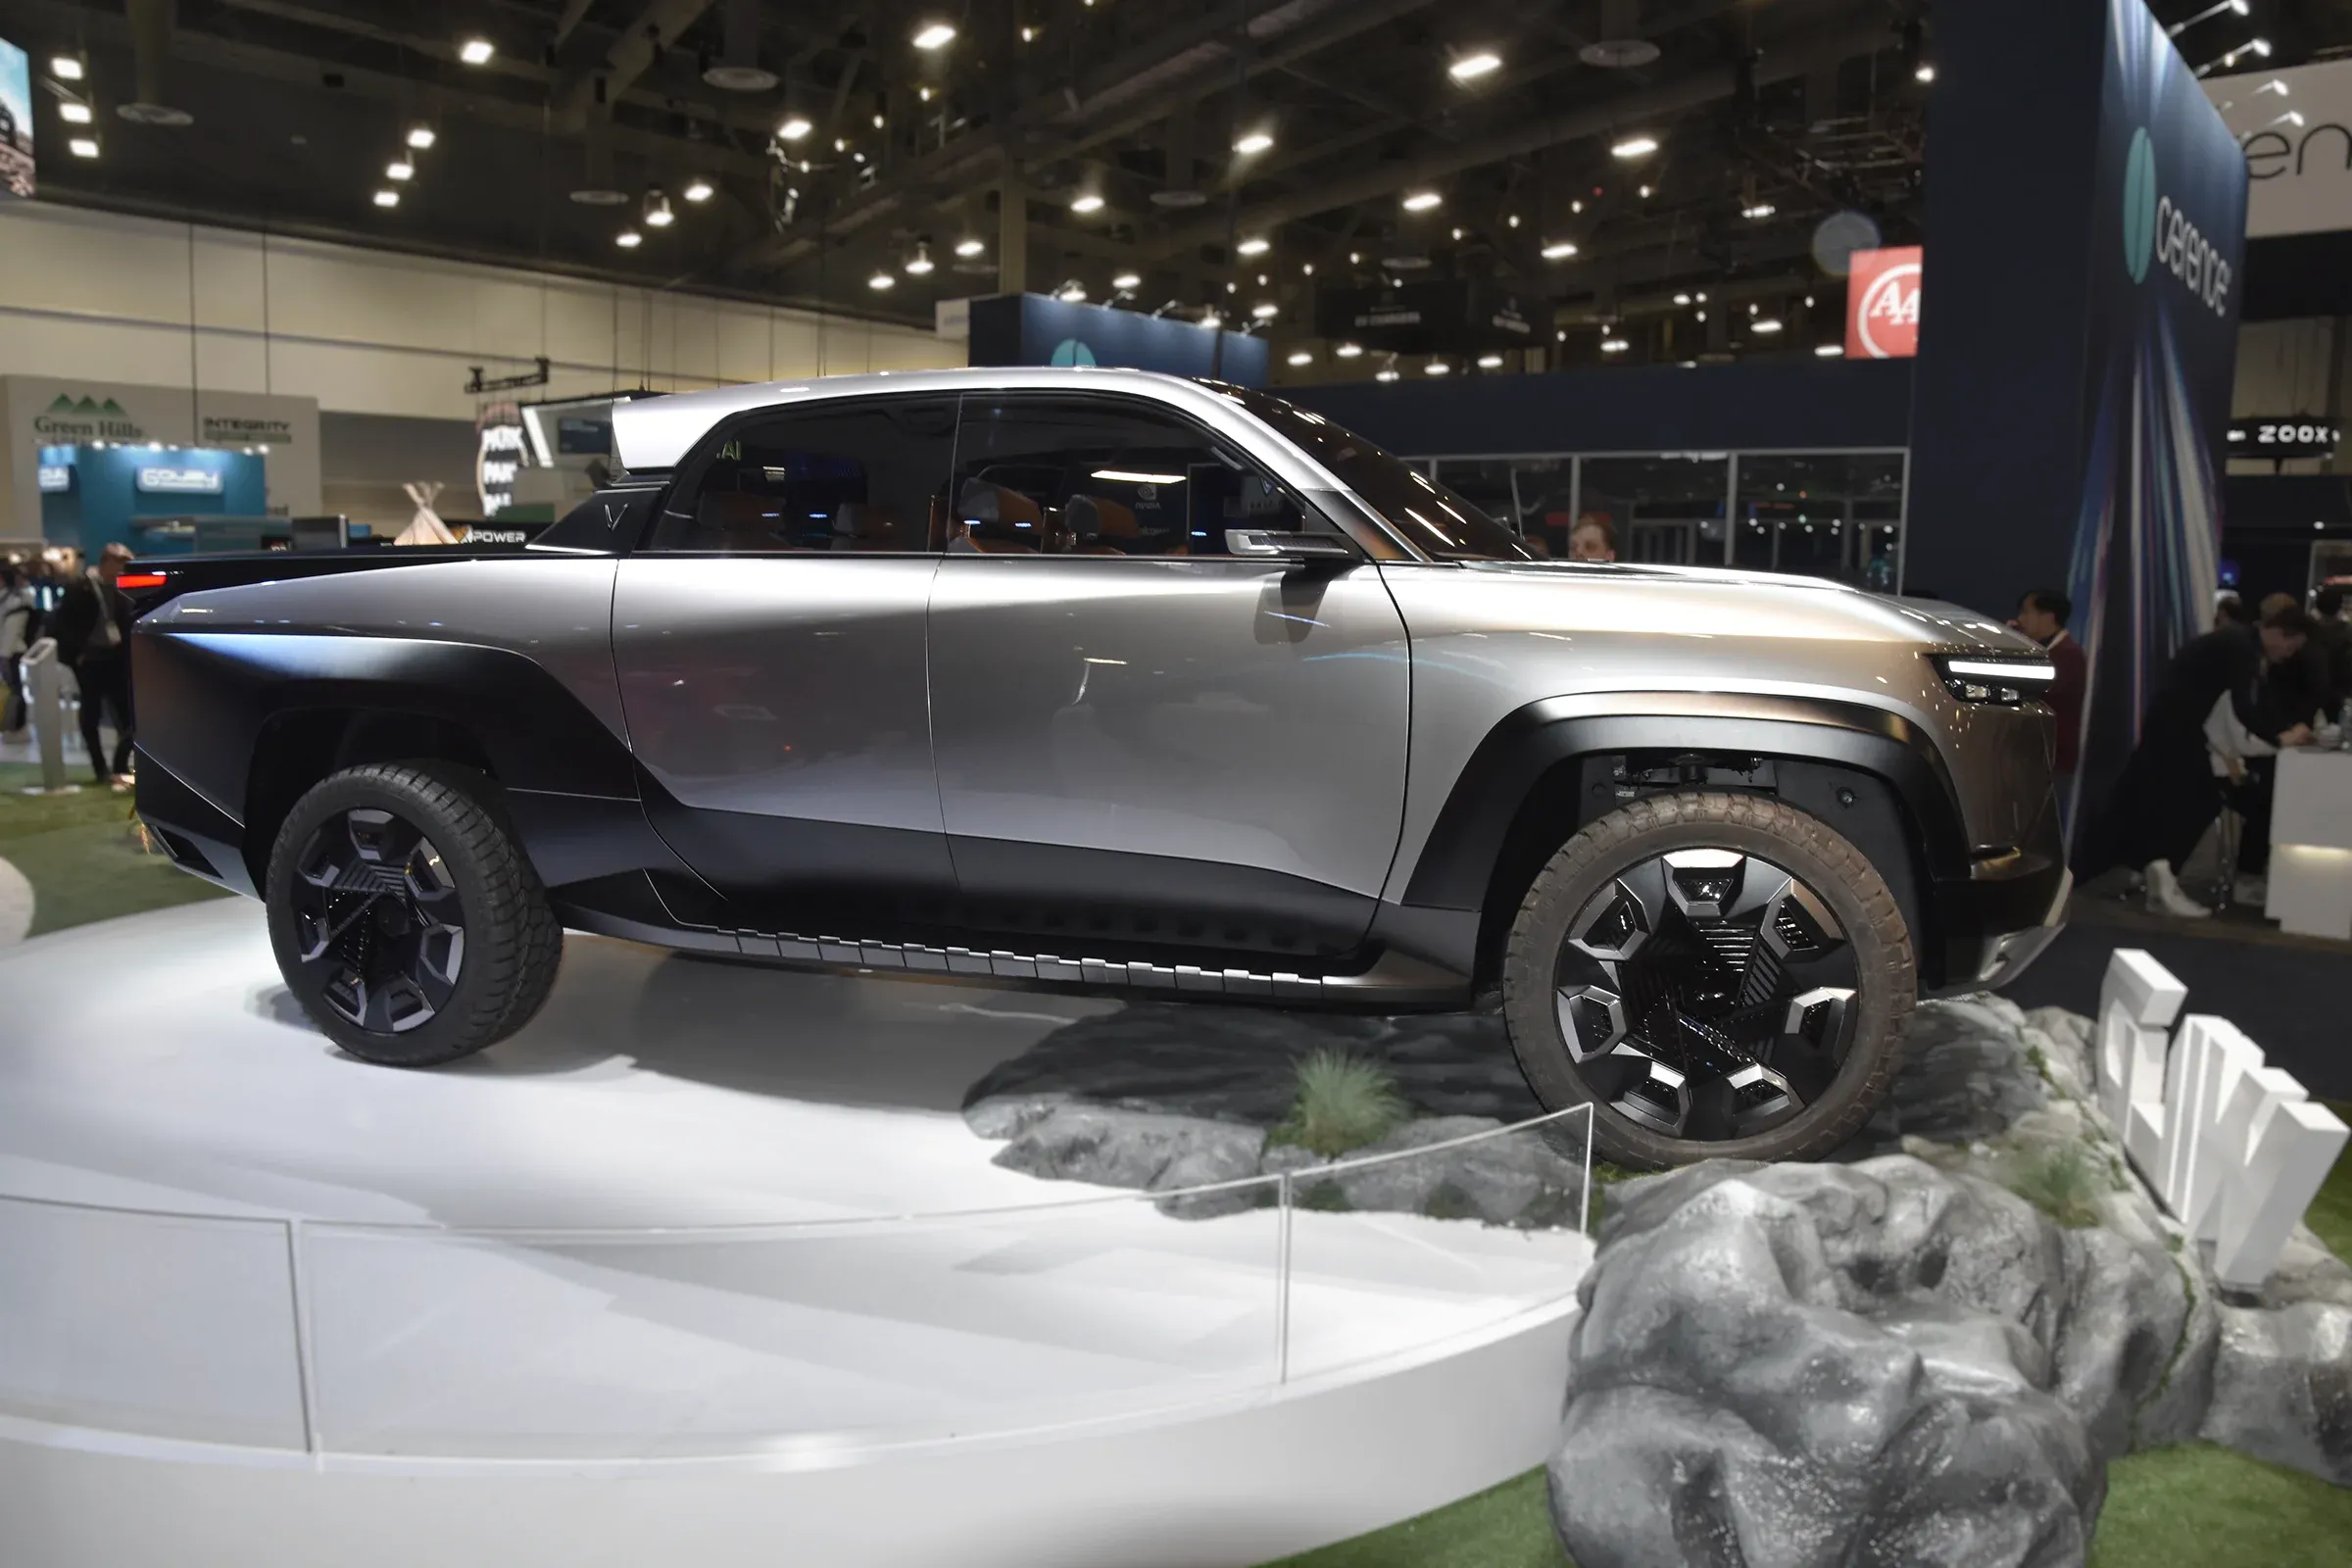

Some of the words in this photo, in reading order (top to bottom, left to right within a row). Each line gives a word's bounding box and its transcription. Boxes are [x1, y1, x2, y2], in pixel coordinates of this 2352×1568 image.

[2155, 195, 2232, 318] cerence
[34, 416, 93, 436] Green
[98, 419, 146, 438] Hills
[204, 416, 291, 432] INTEGRITY
[472, 530, 527, 544] POWER
